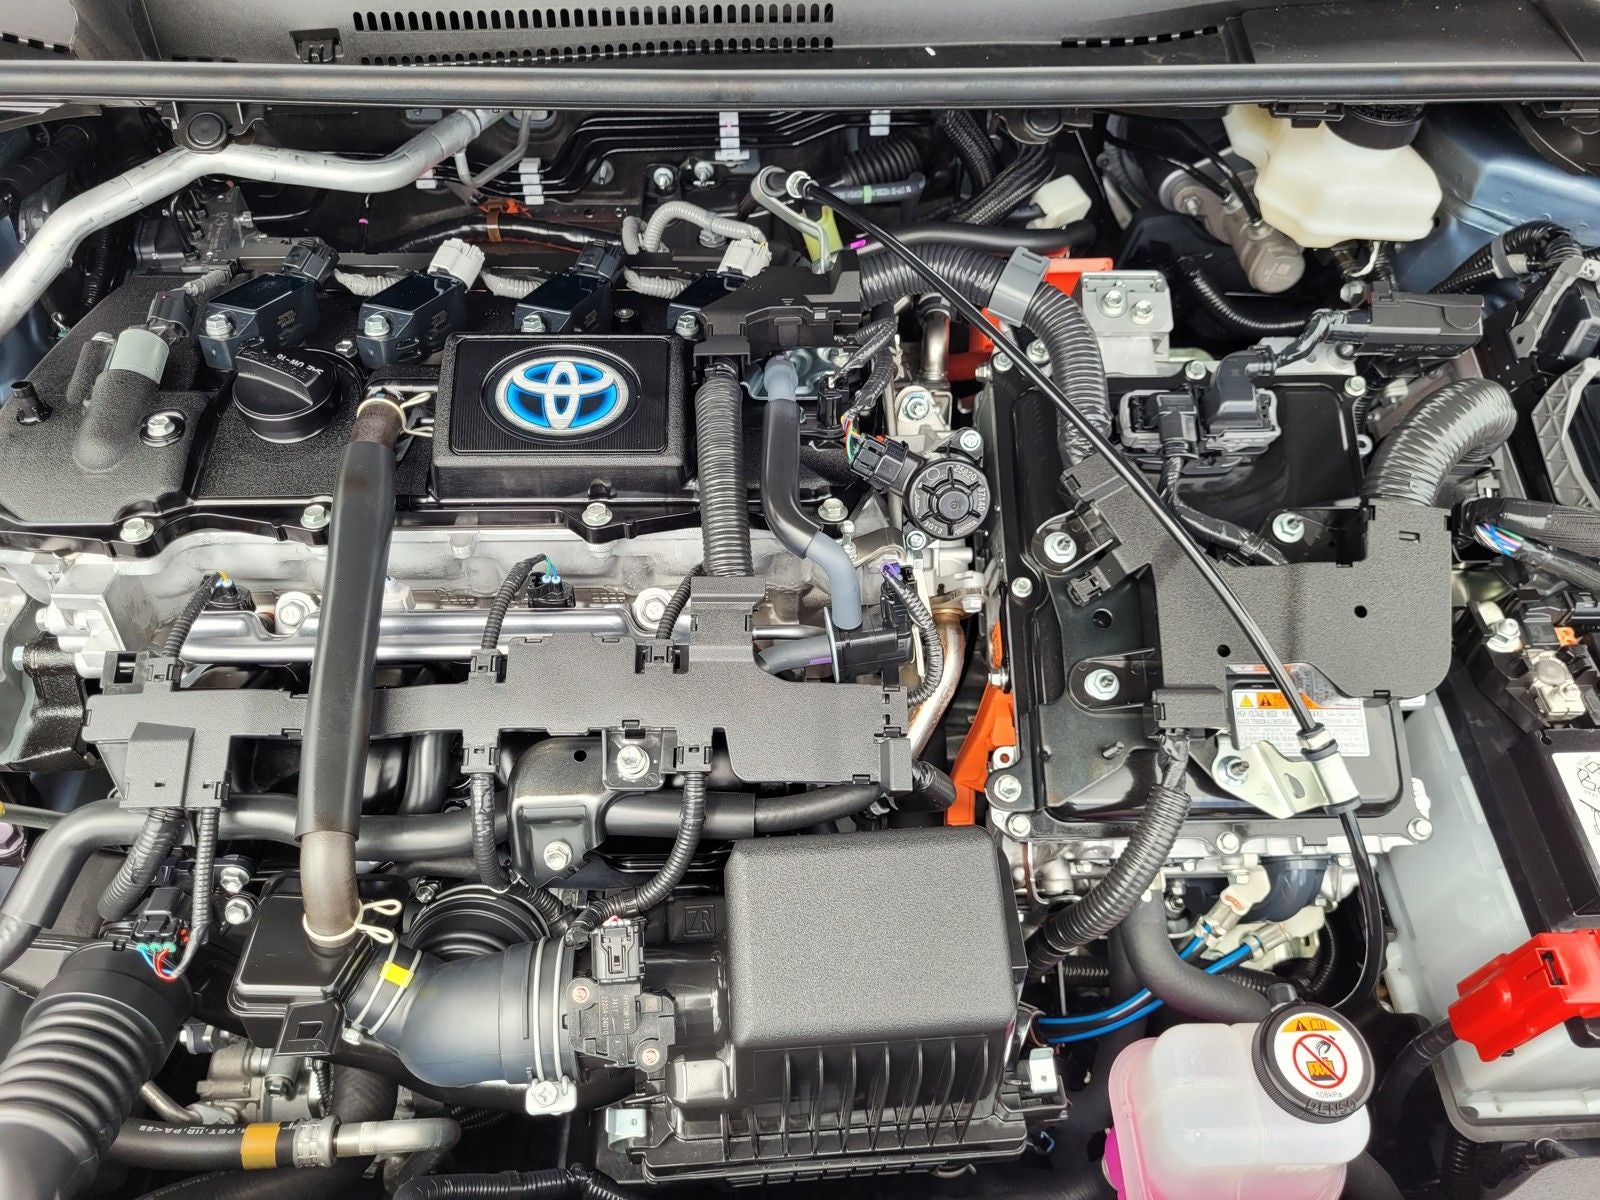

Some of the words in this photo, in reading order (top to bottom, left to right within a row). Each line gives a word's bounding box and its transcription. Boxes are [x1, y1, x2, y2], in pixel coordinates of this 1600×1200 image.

[954, 464, 978, 481] 25620
[977, 487, 986, 511] 37140
[1304, 1097, 1356, 1116] DENSO
